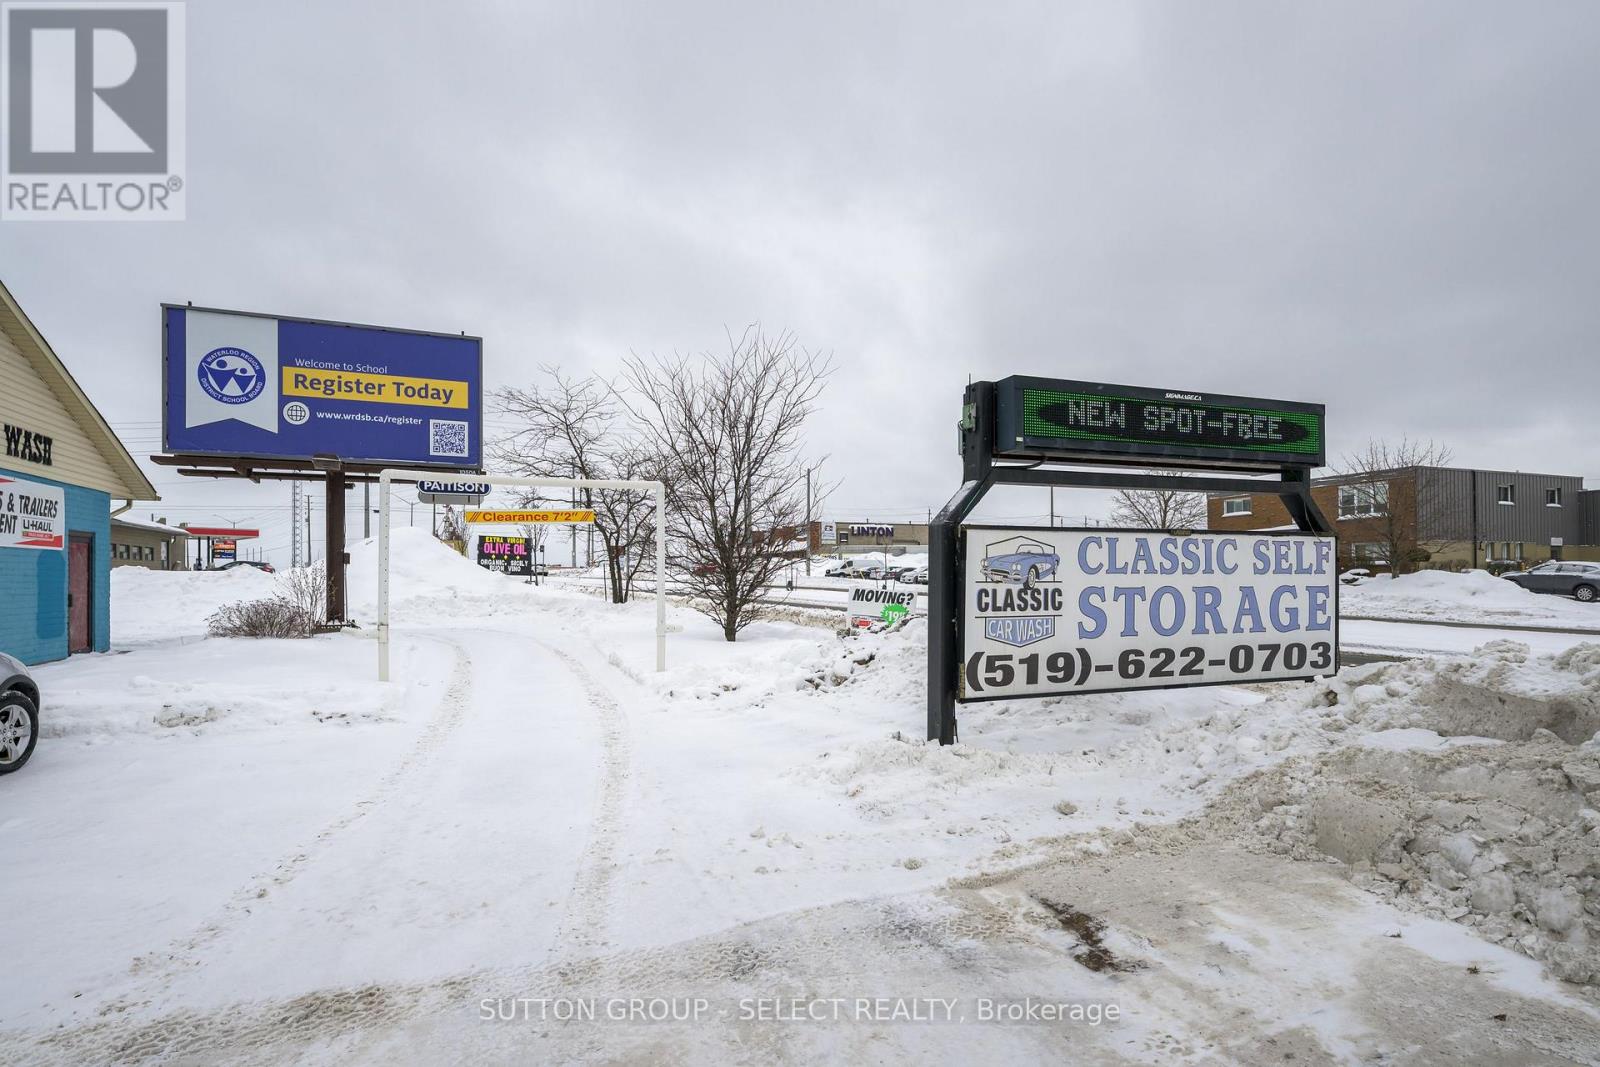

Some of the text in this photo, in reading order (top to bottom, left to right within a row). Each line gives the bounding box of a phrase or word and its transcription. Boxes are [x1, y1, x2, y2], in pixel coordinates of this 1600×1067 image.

[206, 350, 260, 370] WATERLOO REGION
[295, 358, 388, 374] Welcome to School
[201, 378, 222, 399] DISTRICT
[248, 381, 263, 398] BOARD
[294, 373, 454, 404] Register Today
[316, 410, 423, 425] www.wrdsb.ca/register
[1069, 399, 1283, 440] NEW SPOT-FREE
[4, 423, 53, 466] WASH
[424, 481, 485, 492] PATTISON
[19, 495, 58, 518] TRAILERS
[483, 512, 549, 522] Clearance
[851, 526, 894, 537] LINTON
[484, 543, 527, 555] OLIVE OIL
[1077, 536, 1332, 576] CLASSIC SELF
[852, 588, 914, 605] MOVING?
[976, 588, 1063, 612] CLASSIC
[1078, 584, 1332, 640] STORAGE
[988, 618, 1052, 642] CAR WASH
[966, 642, 1332, 691] (519)-622-0703
